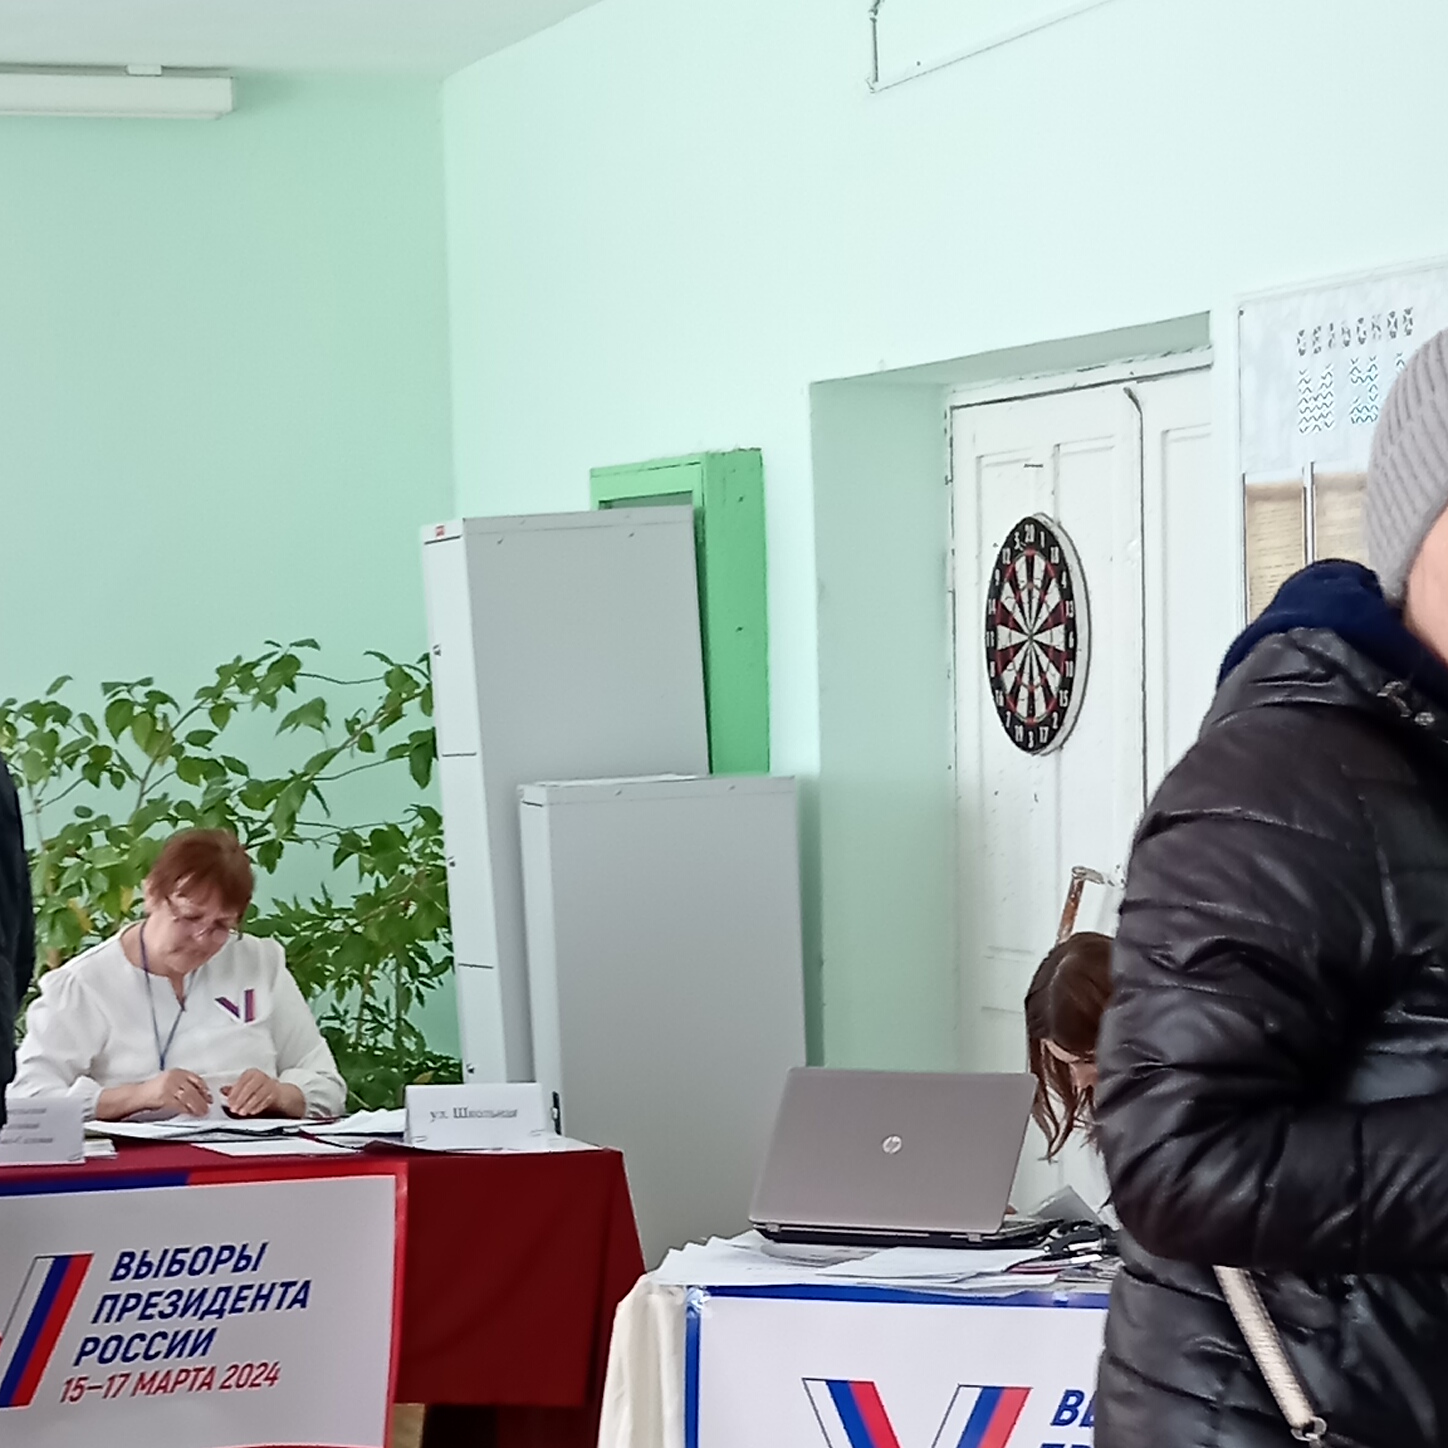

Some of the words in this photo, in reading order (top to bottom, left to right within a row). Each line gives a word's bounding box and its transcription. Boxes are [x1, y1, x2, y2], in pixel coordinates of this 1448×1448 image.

[109, 1241, 269, 1282] ВЫБОРЫ
[90, 1279, 312, 1325] ПРЕЗИДЕНТА
[73, 1327, 218, 1367] РОССИИ
[130, 1367, 213, 1398] МАРТА
[219, 1360, 281, 1390] 2024
